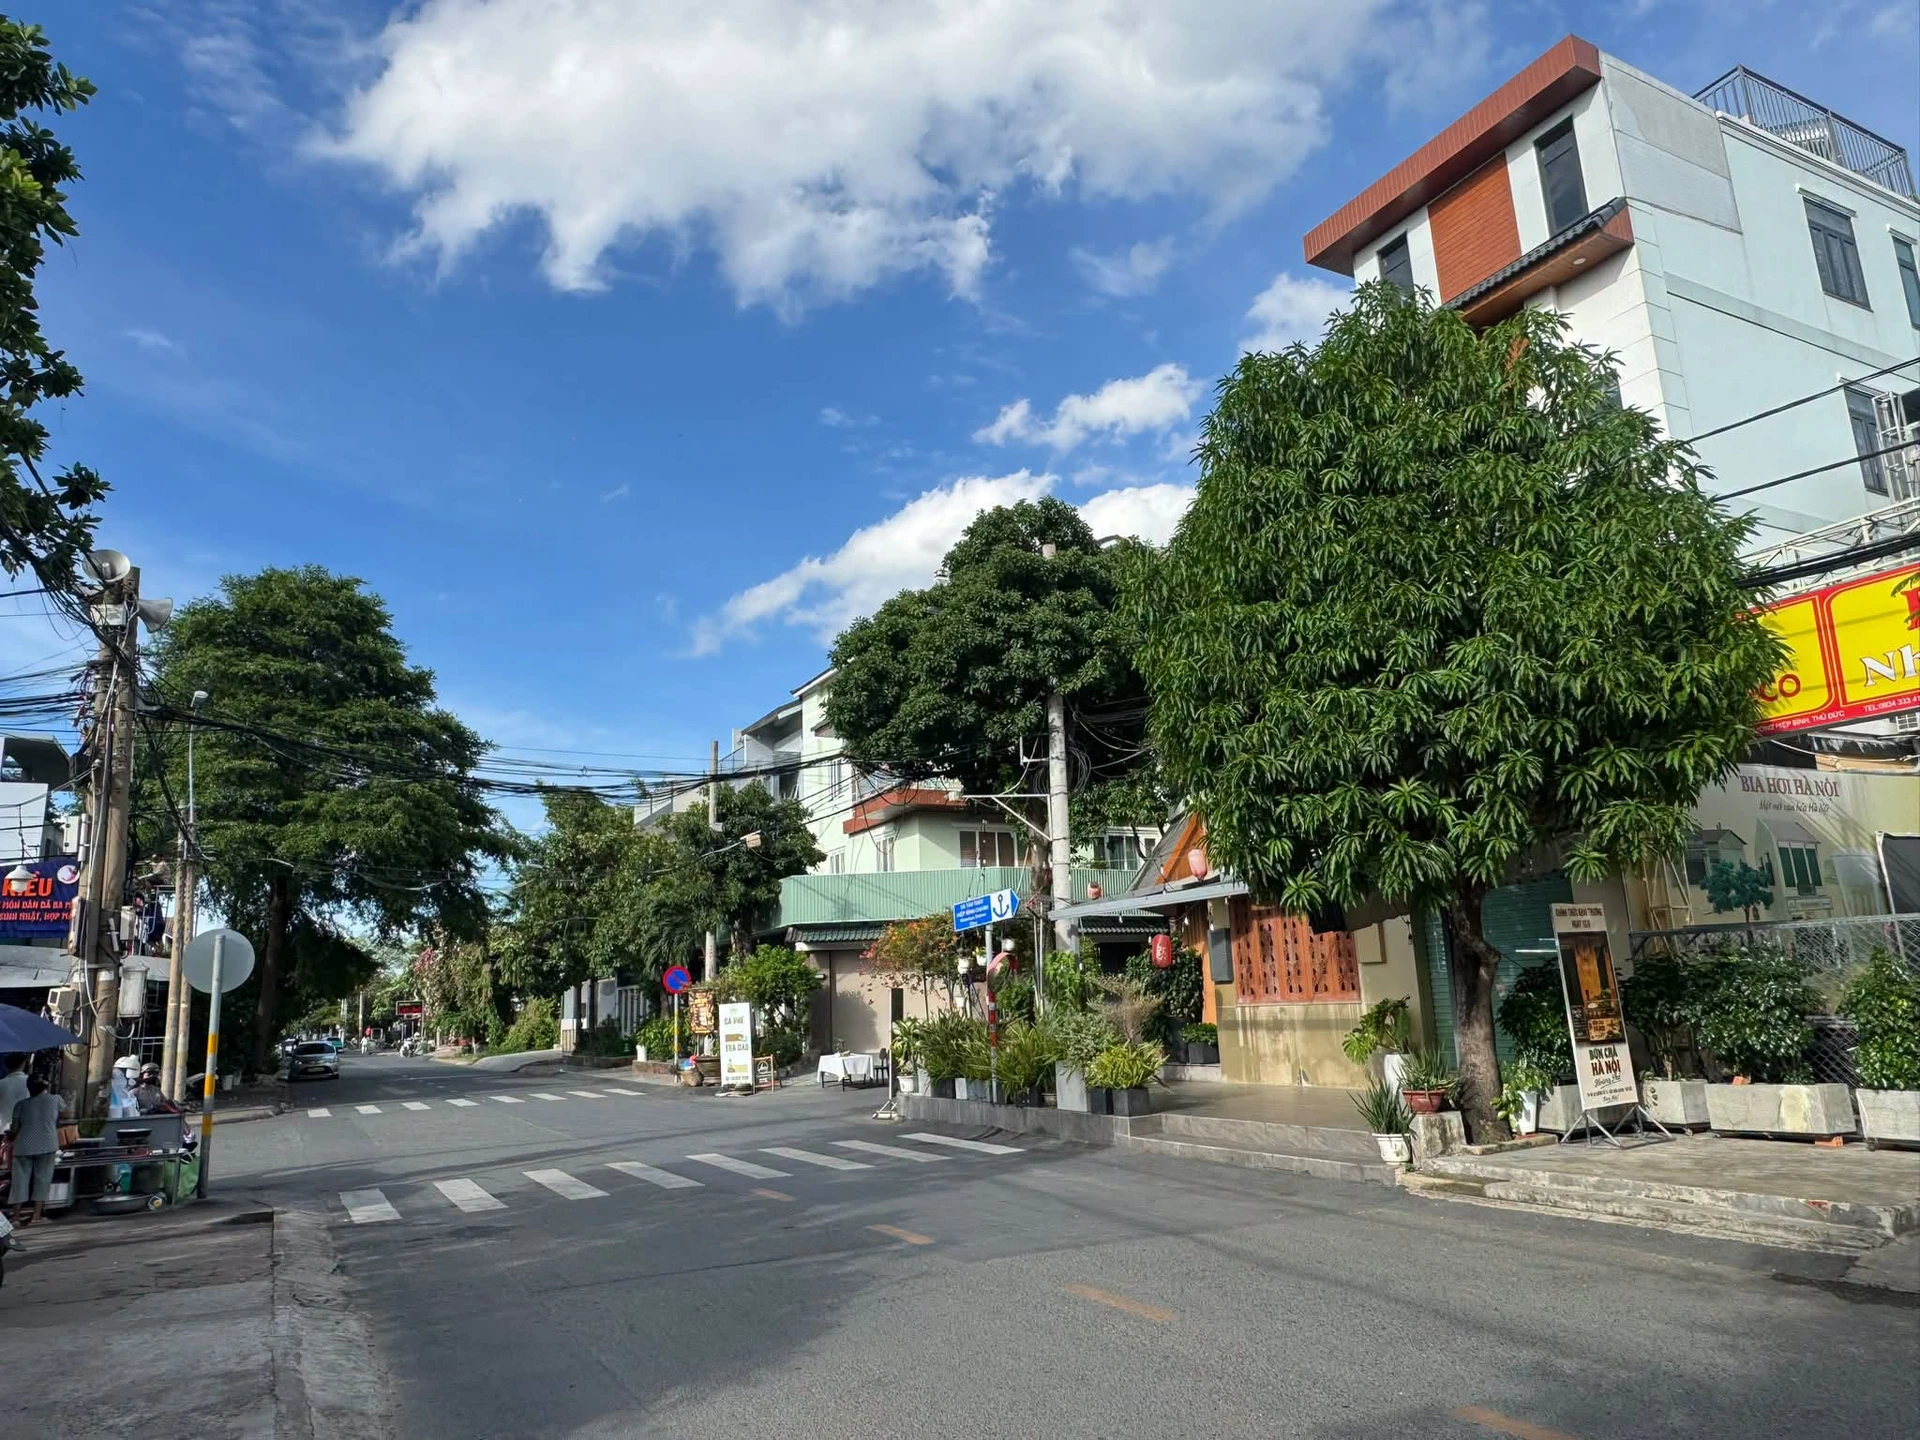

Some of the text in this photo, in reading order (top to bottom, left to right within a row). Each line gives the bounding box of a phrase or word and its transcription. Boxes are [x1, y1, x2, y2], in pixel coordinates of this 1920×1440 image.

[1740, 775, 1840, 801] BIA HƠI HÀ NỘI
[1591, 1058, 1622, 1077] HÀ NỘI
